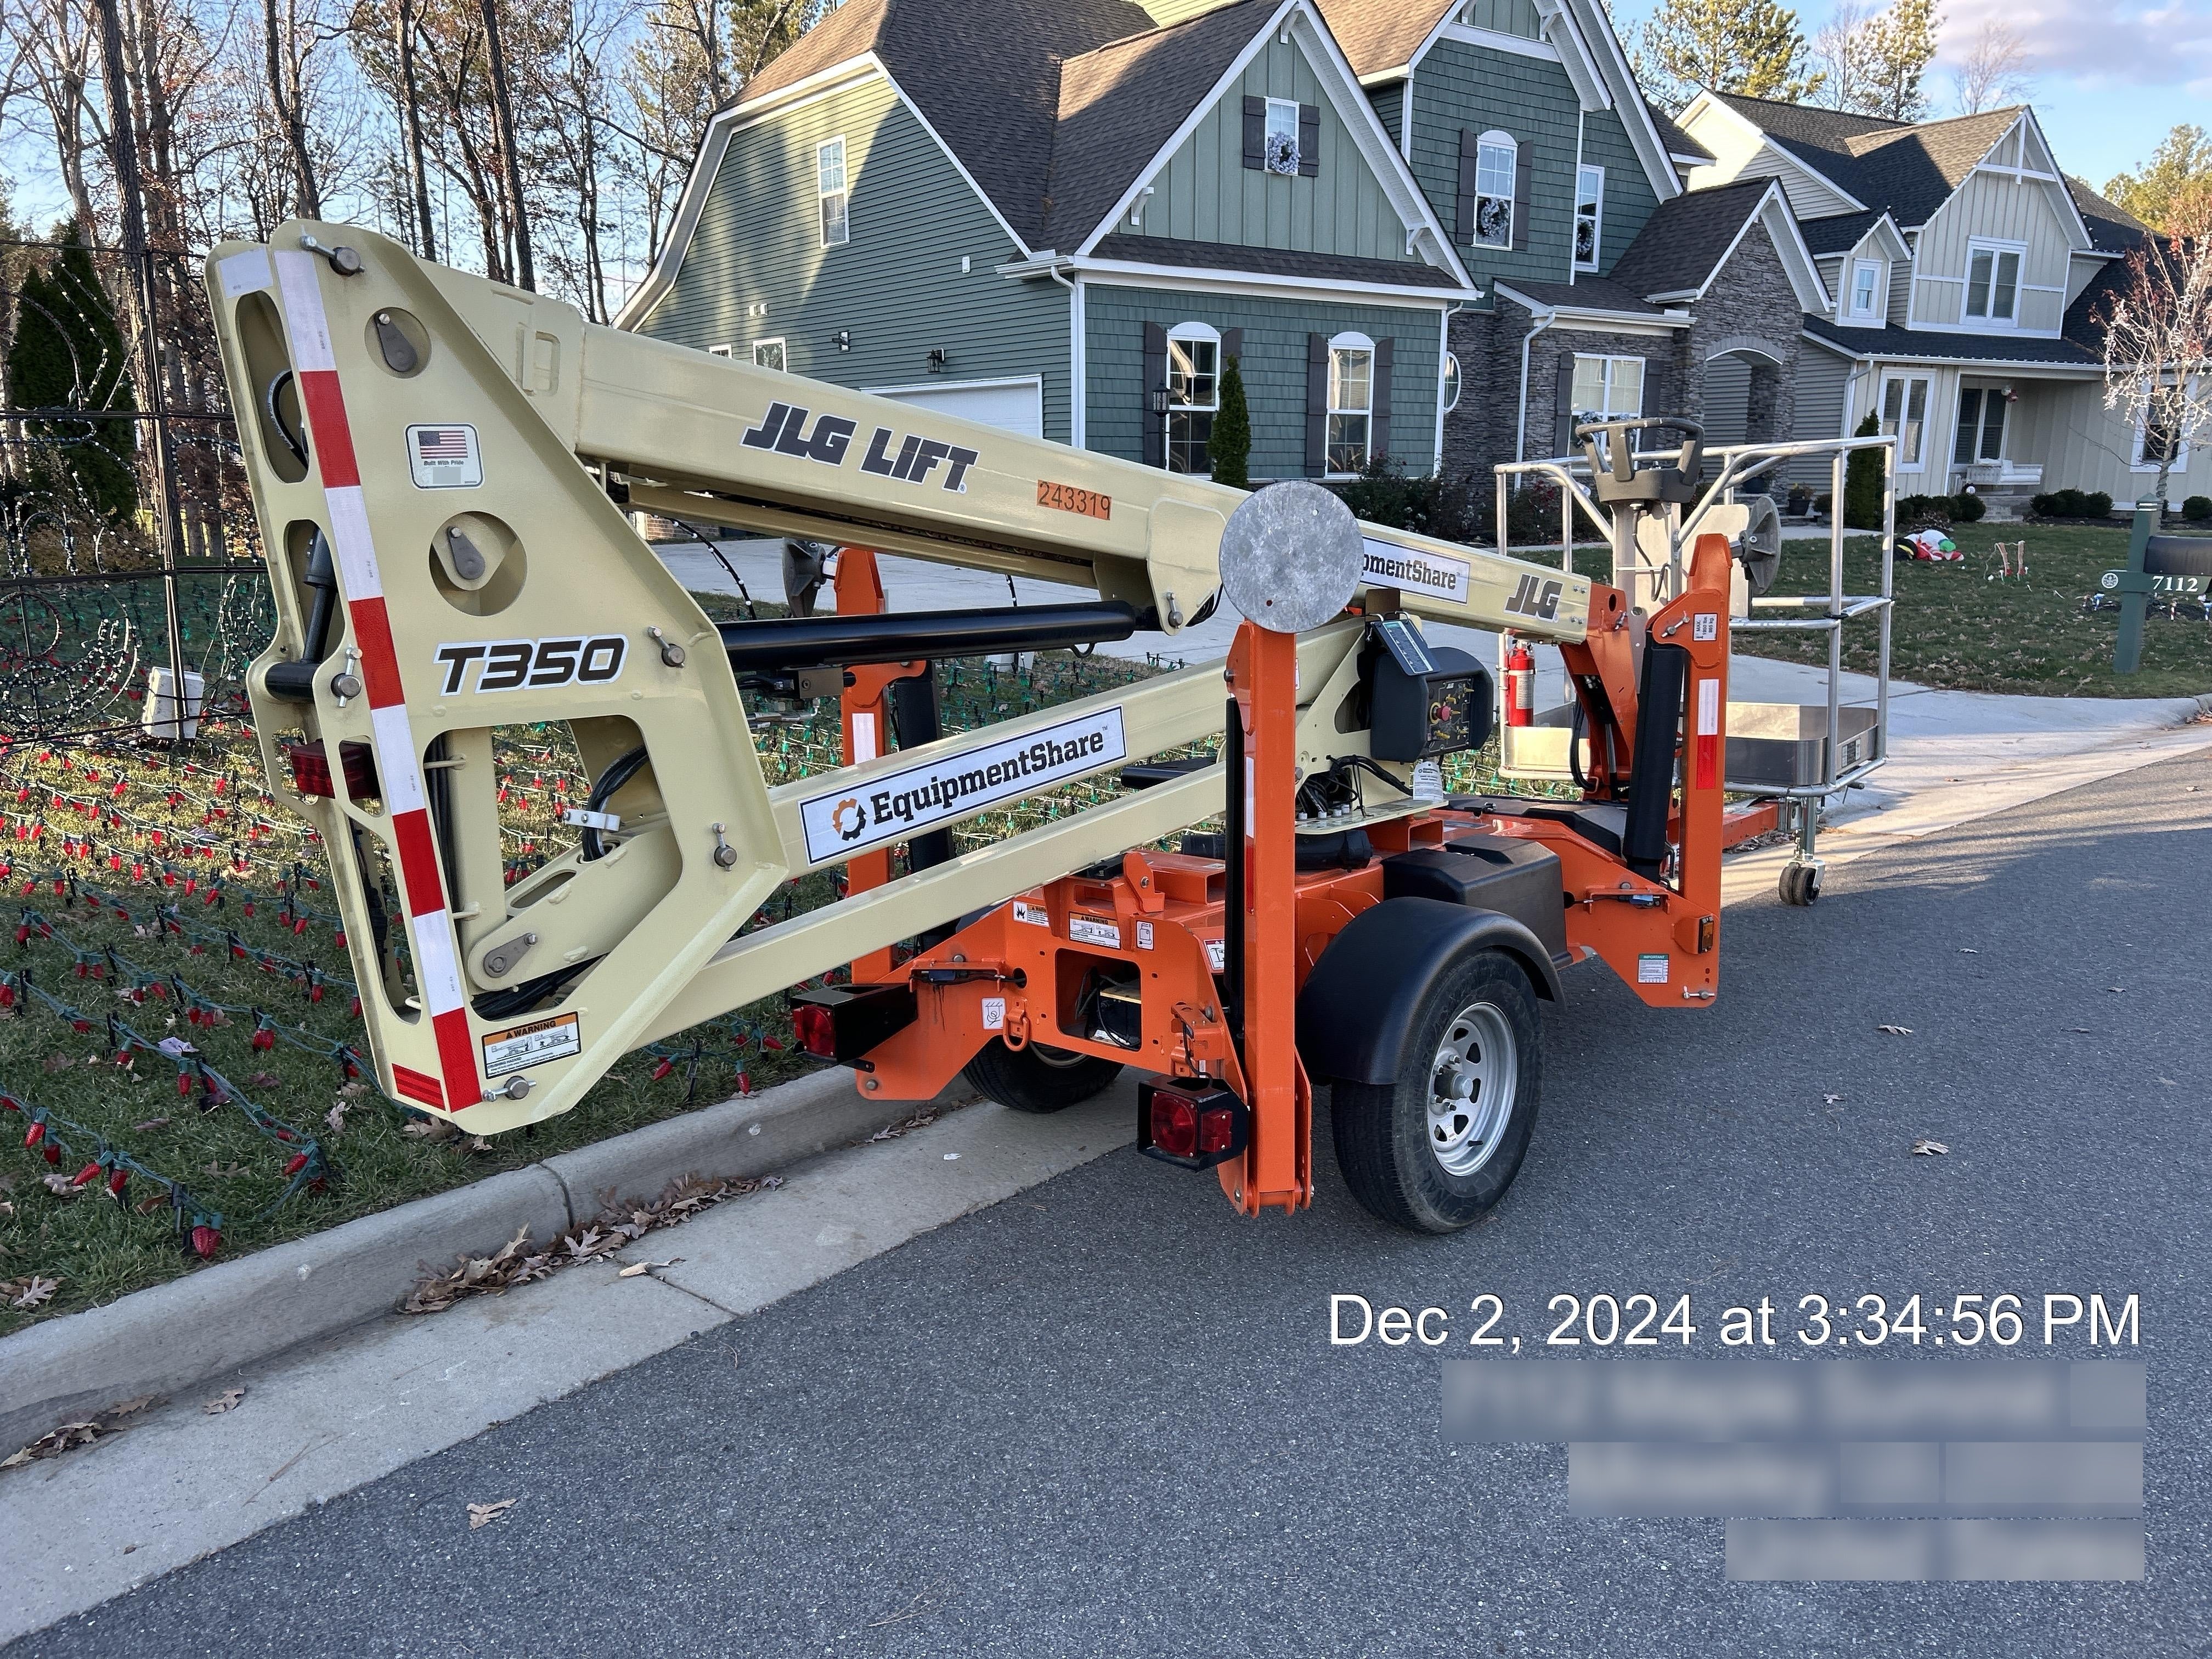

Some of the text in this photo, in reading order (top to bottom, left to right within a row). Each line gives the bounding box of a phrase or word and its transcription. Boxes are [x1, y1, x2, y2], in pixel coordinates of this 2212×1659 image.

[741, 401, 858, 466] JLG
[1039, 481, 1111, 519] 243319
[1505, 574, 1564, 620] JLG
[2152, 575, 2198, 592] 7112
[437, 636, 625, 694] T350
[870, 731, 1104, 826] EquipmentShare
[1085, 916, 1109, 925] WARNING
[513, 1020, 556, 1037] WARNING
